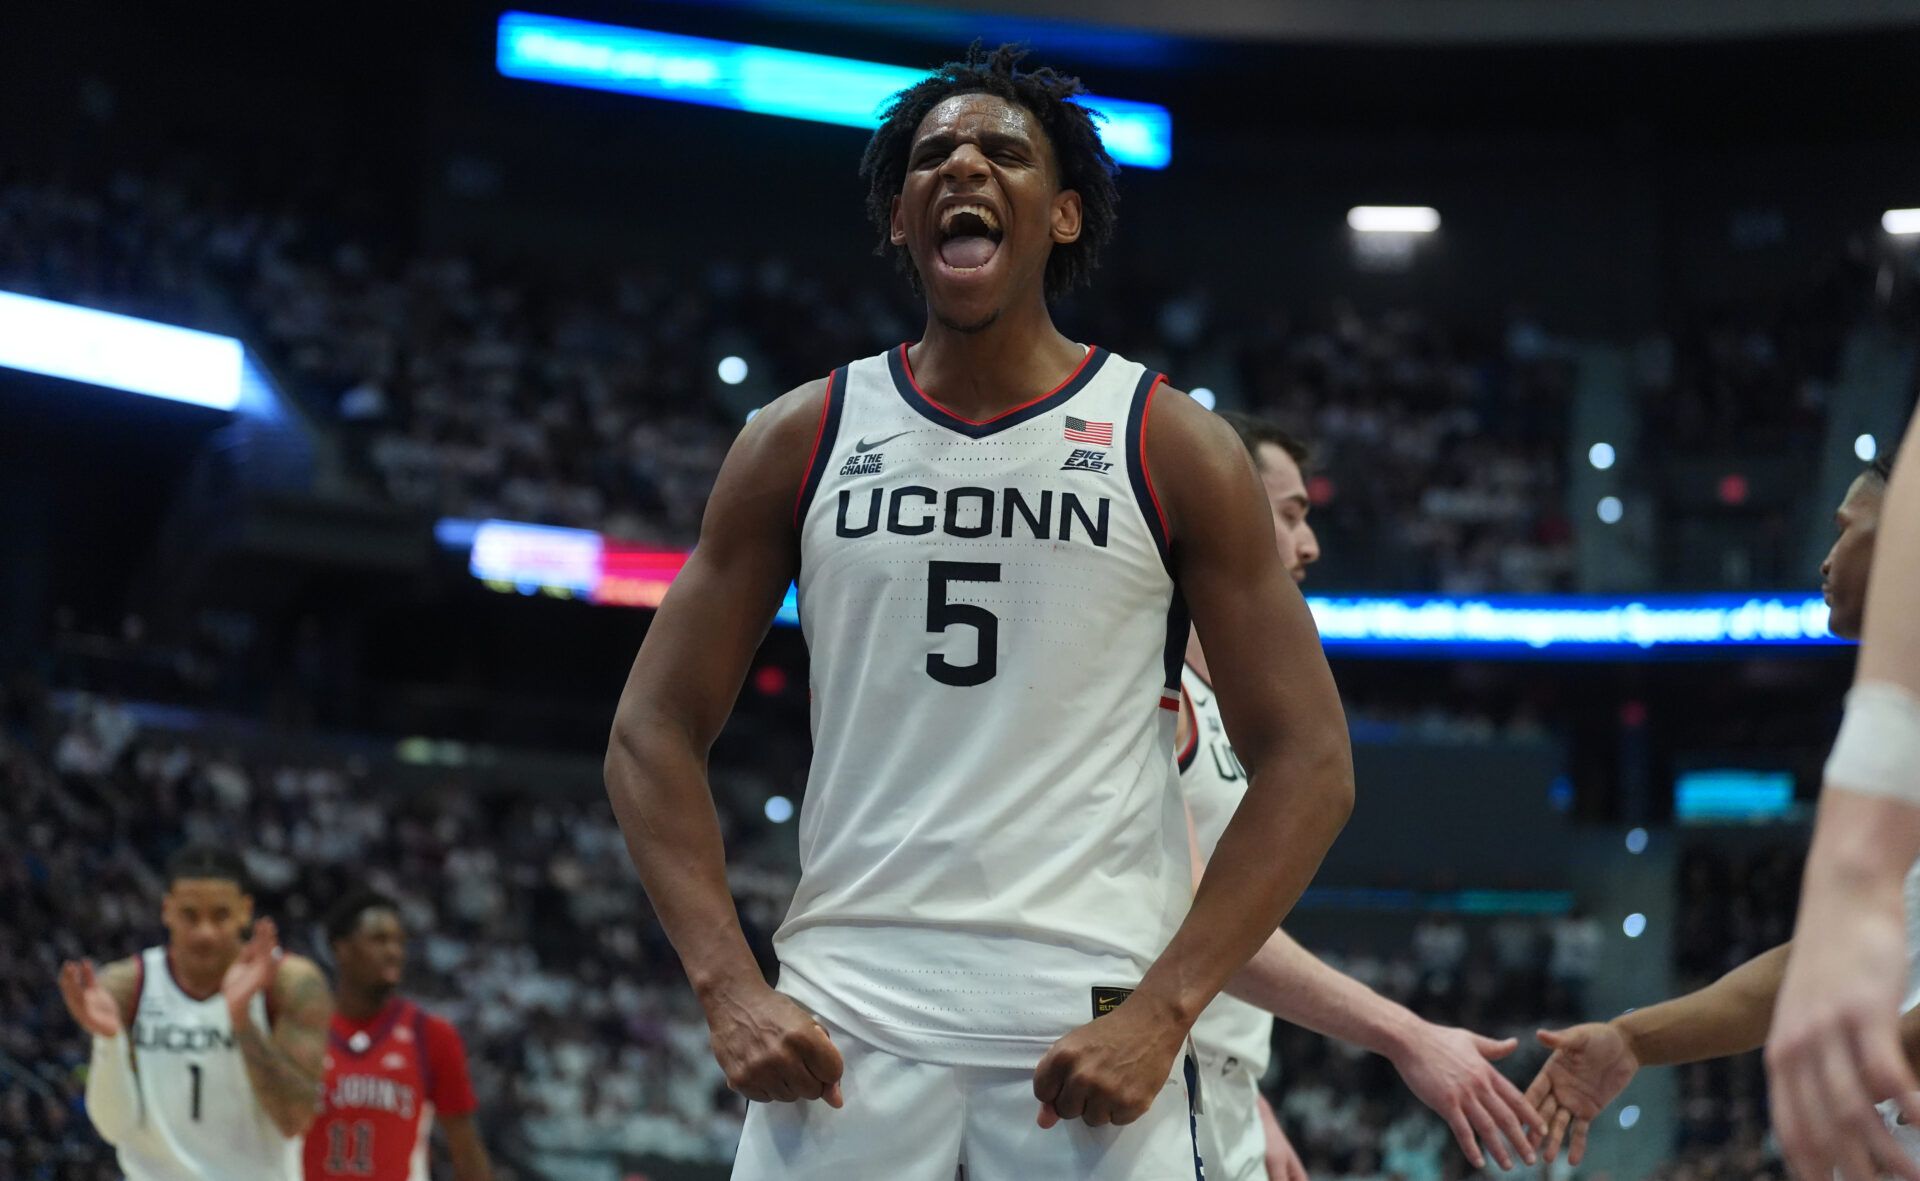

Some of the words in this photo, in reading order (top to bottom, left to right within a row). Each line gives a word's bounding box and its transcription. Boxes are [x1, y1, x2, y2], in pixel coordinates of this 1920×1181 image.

[839, 463, 883, 476] CHANGE
[846, 455, 861, 465] BE
[863, 453, 883, 463] THE
[1064, 457, 1114, 471] EAST
[1070, 449, 1107, 460] BIG
[835, 486, 1110, 547] UCONN
[926, 560, 1001, 687] 5
[135, 1023, 236, 1053] UCON
[187, 1062, 203, 1122] 1
[325, 1120, 374, 1175] 11
